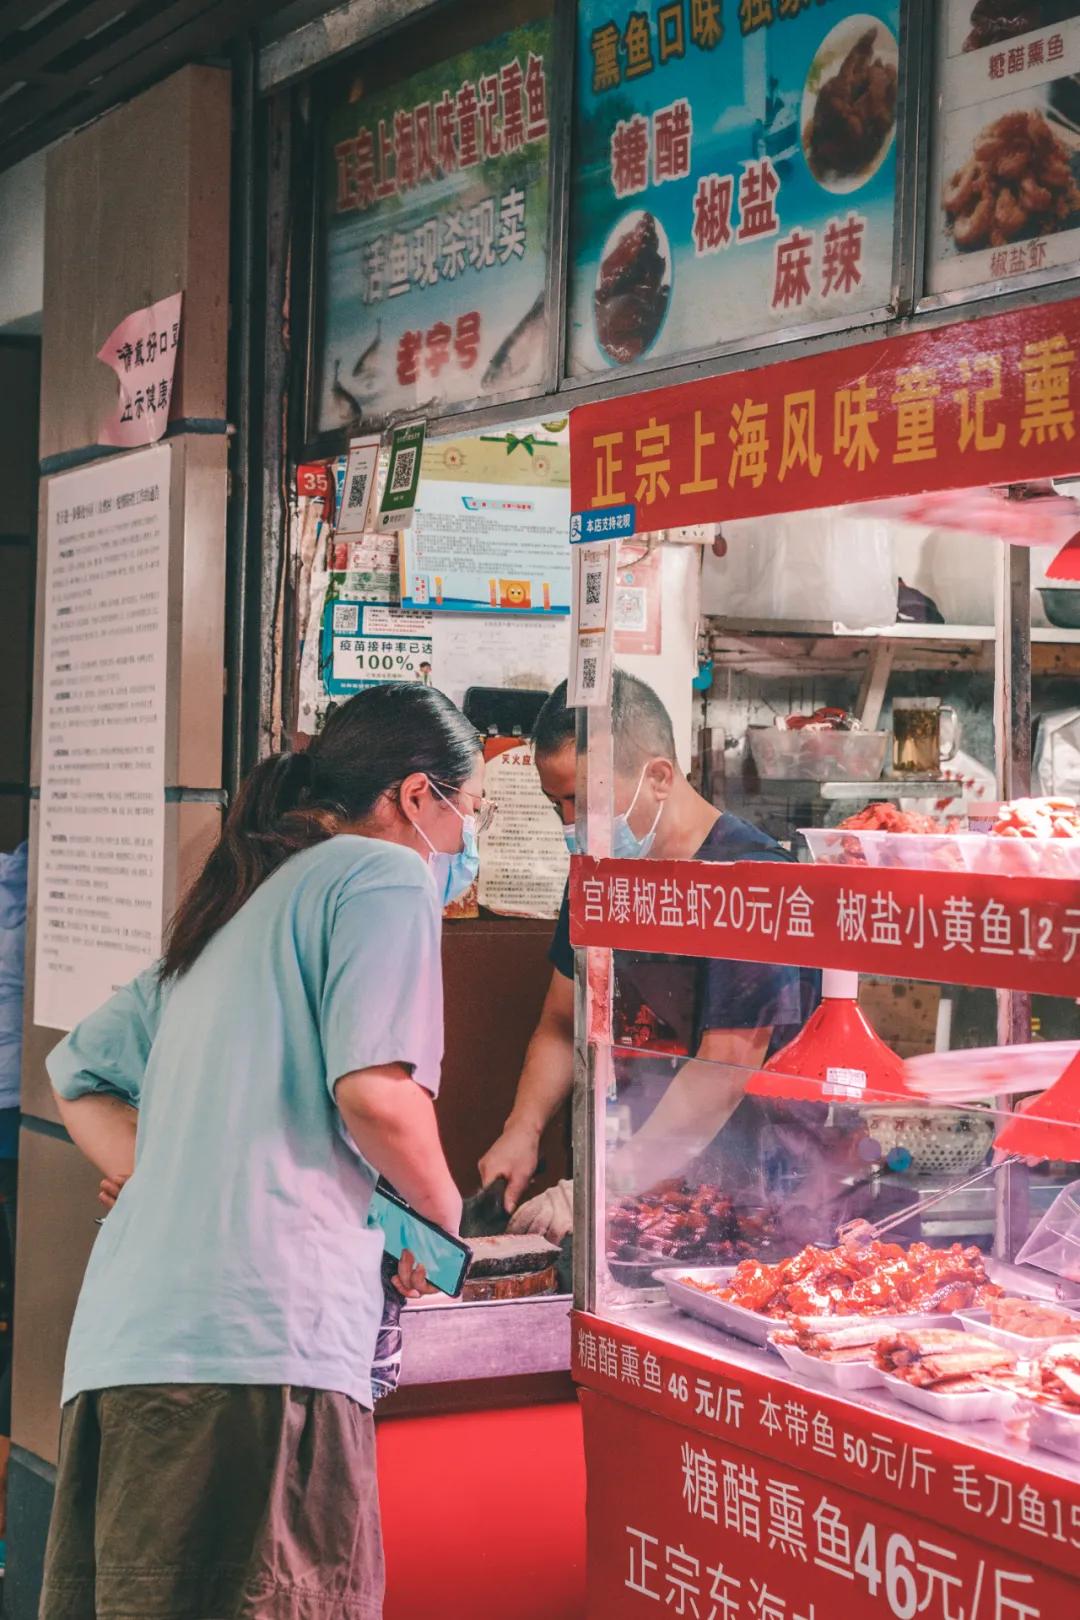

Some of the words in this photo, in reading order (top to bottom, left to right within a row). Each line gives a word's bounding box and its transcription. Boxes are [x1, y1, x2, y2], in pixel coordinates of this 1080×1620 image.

[592, 0, 723, 92] 熏鱼口味
[989, 33, 1064, 80] 糖醋熏鱼
[335, 51, 548, 212] 正宗上海风味童记熏鱼
[611, 98, 693, 198] 糖醋
[363, 187, 527, 304] 活鱼现杀现卖
[691, 157, 781, 257] 椒盐
[771, 212, 865, 310] 麻辣
[990, 238, 1048, 278] 椒盐虾
[396, 310, 481, 386] 老字号
[590, 335, 1077, 508] 正宗上海风味童记熏
[303, 472, 328, 492] 35
[586, 513, 631, 533] 本店支持花呗
[339, 639, 432, 654] 疫苗接种率已达
[356, 654, 414, 671] 100%
[582, 876, 815, 941] 宫爆椒盐虾20元/盒
[624, 1526, 816, 1620] 正宗东海
[681, 1441, 1041, 1620] 糖醋熏鱼46元/斤
